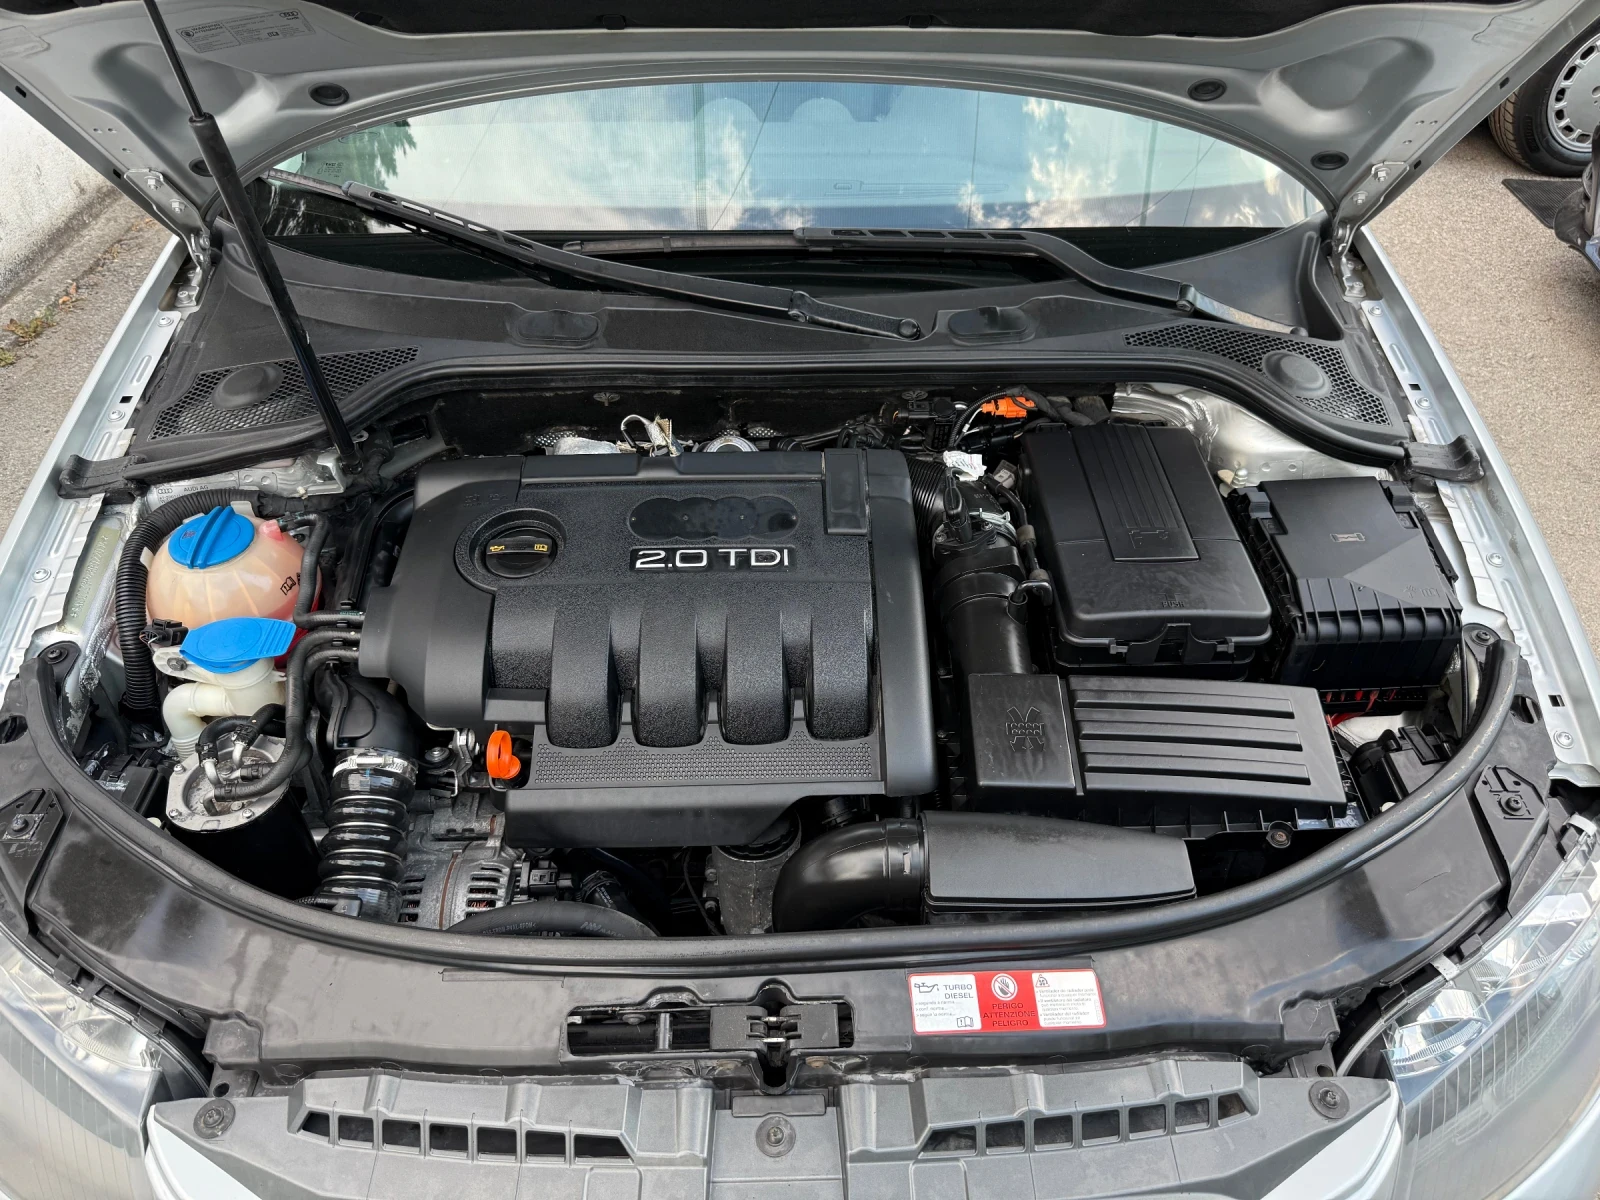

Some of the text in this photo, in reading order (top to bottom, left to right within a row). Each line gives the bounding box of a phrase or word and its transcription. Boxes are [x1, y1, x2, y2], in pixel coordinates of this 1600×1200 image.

[635, 548, 789, 568] 2.0 TDI
[1161, 600, 1185, 608] PUSH
[944, 992, 974, 1000] DIESEL
[992, 1002, 1024, 1010] PERIGO
[983, 1010, 1036, 1019] ATTENZIONE
[992, 1019, 1029, 1027] PELIGRO
